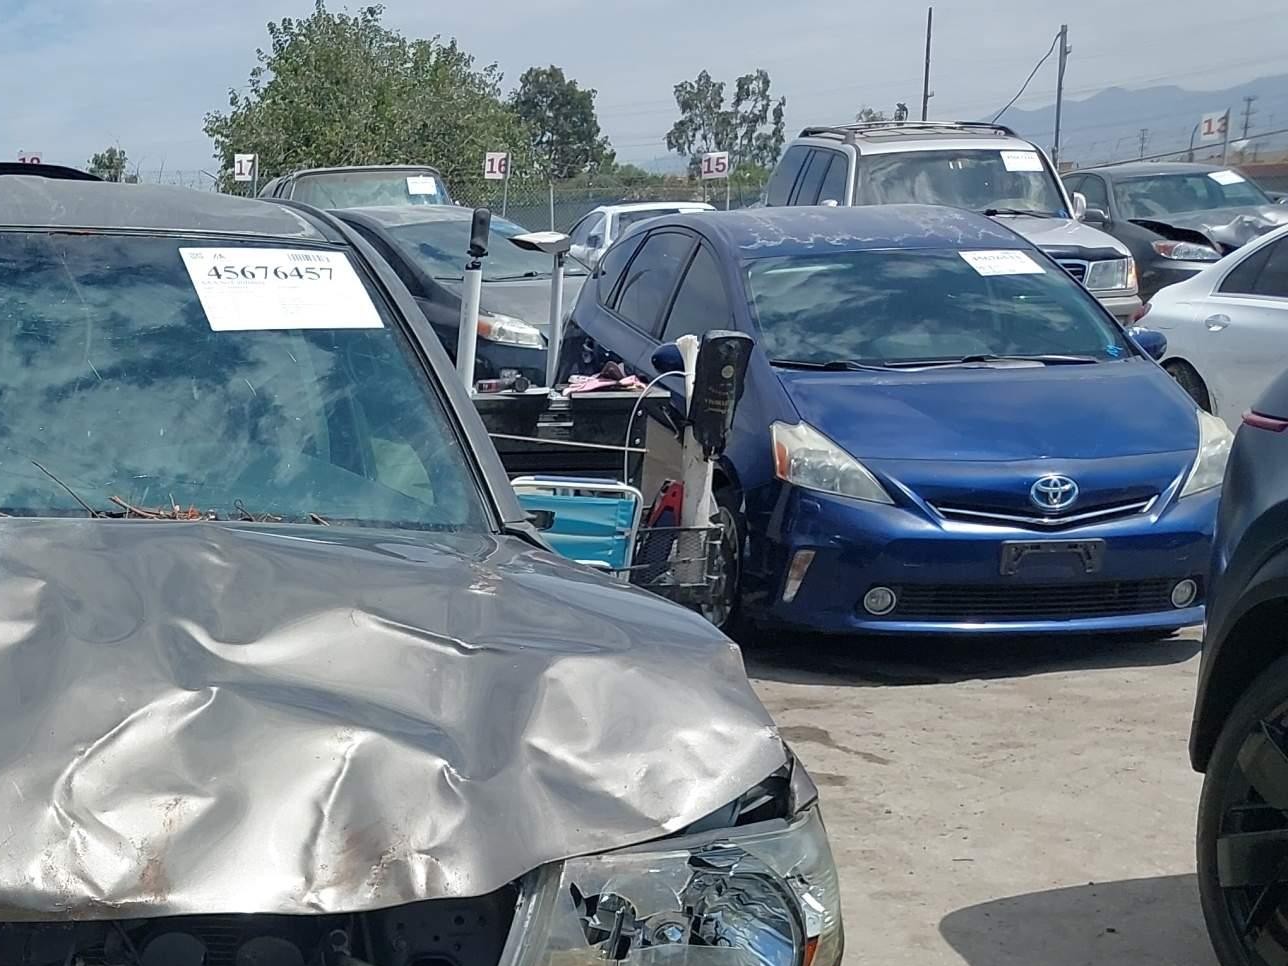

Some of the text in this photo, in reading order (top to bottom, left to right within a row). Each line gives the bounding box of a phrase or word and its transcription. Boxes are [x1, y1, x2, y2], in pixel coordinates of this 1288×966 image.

[236, 160, 255, 176] 17
[487, 158, 507, 174] 16
[704, 157, 726, 174] 15
[207, 265, 333, 280] 45676457
